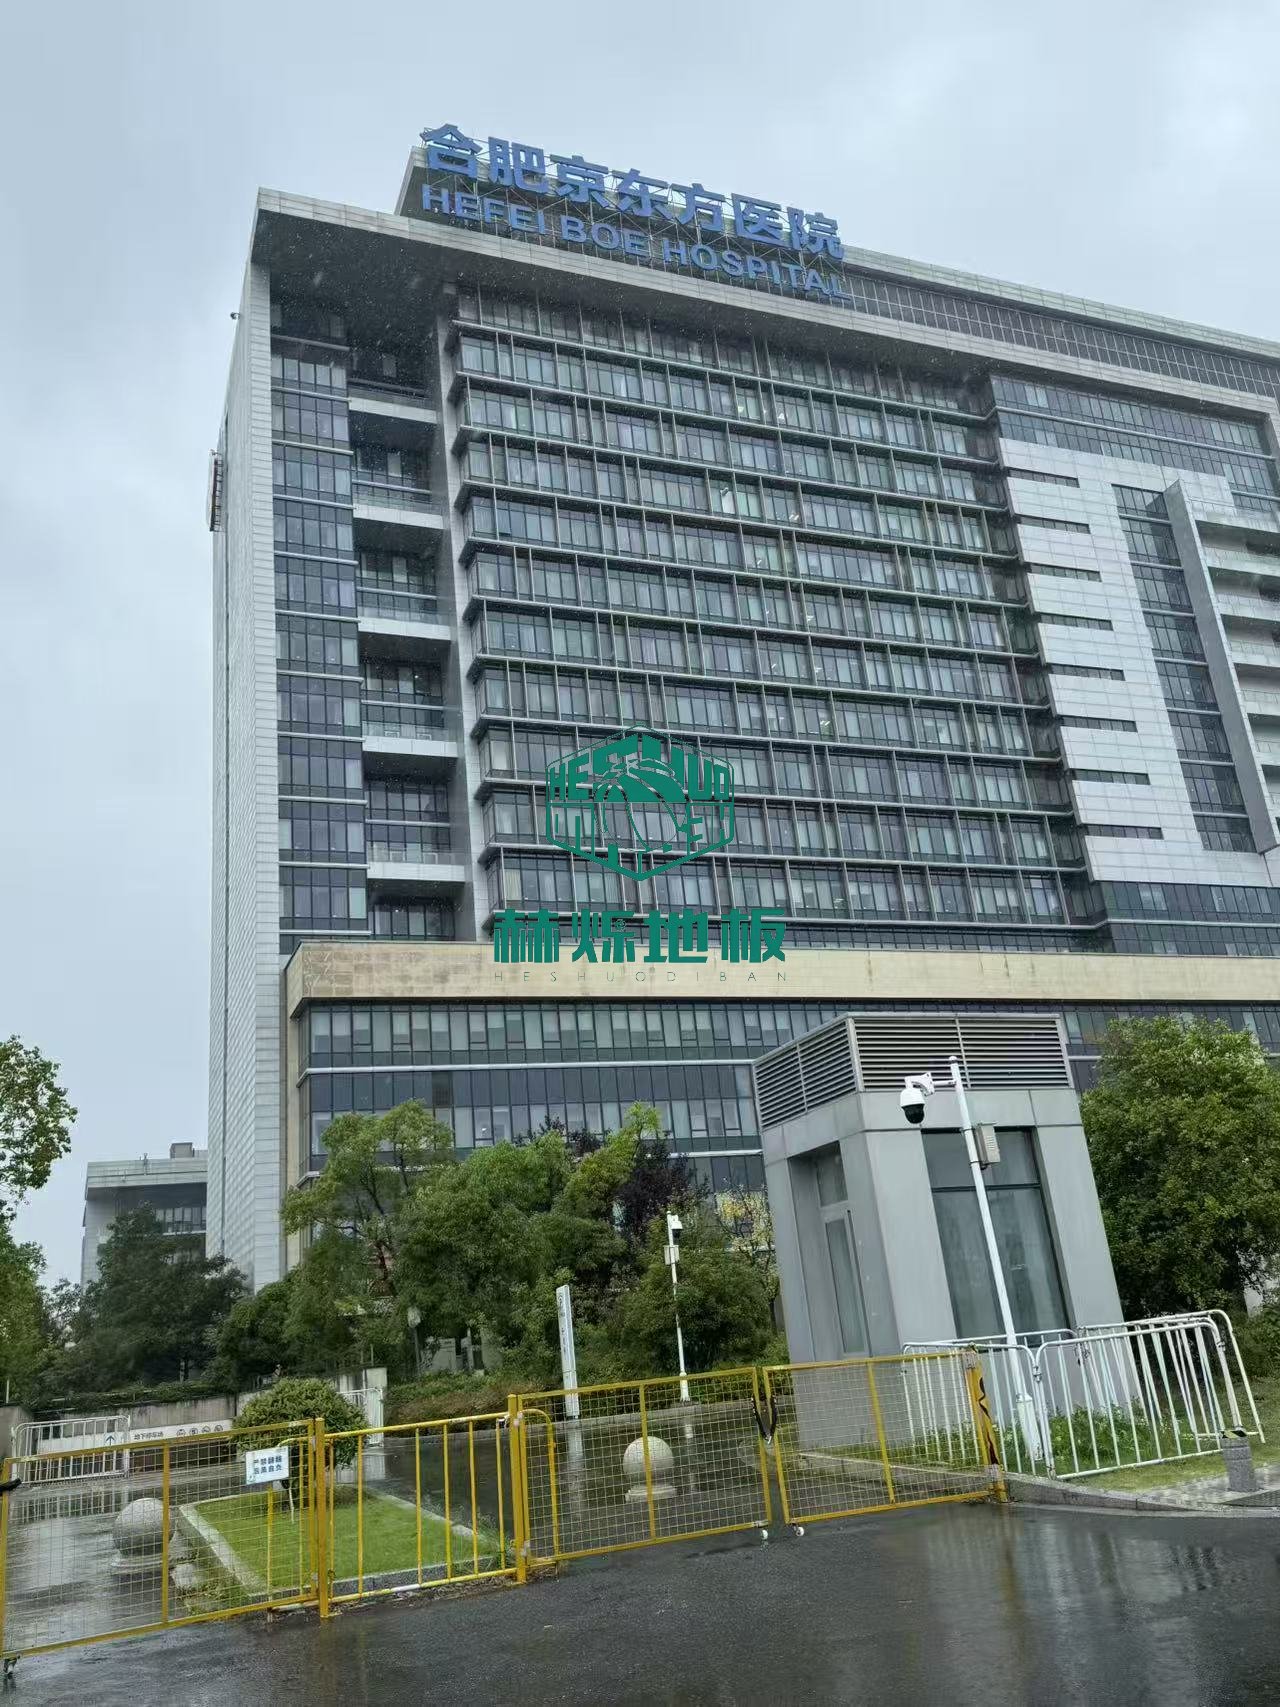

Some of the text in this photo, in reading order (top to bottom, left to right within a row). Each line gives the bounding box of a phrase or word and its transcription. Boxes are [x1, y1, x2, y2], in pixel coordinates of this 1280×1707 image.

[420, 123, 844, 260] 合肥京东方医院
[422, 183, 852, 301] HEFEI BOE HOSPITAL
